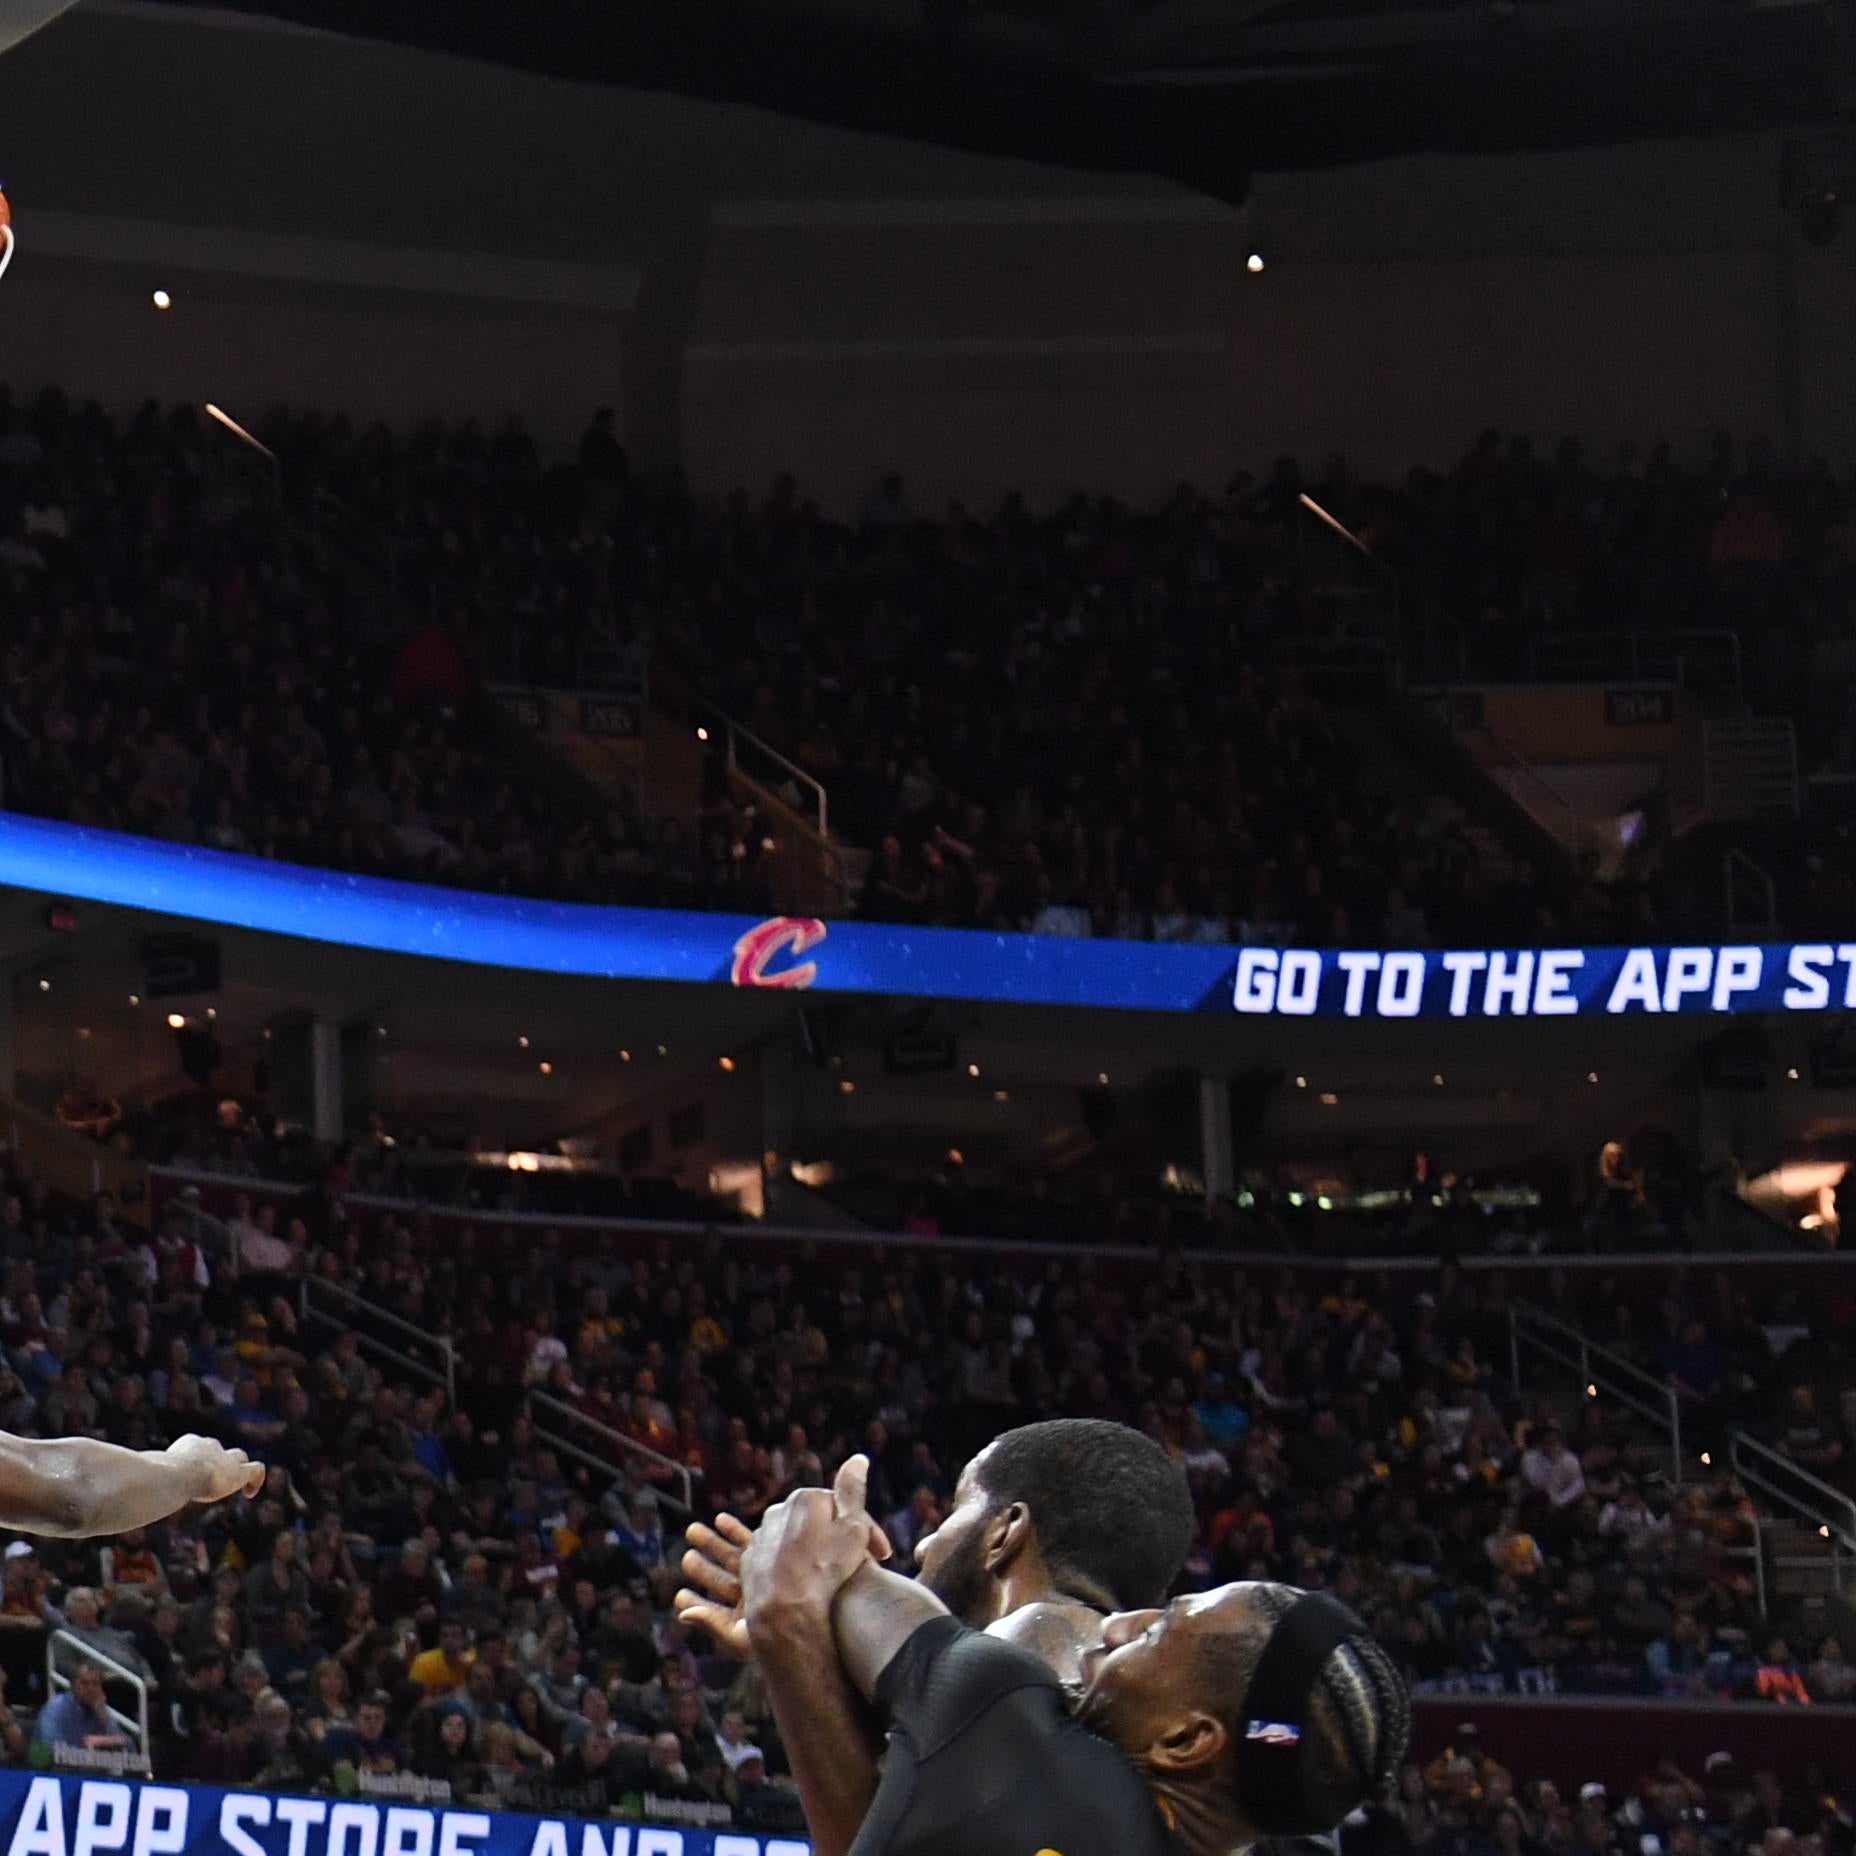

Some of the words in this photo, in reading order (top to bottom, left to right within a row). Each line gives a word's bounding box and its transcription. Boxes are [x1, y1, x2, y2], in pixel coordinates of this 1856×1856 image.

[1234, 947, 1322, 1015] GO
[1337, 951, 1427, 1017] TO
[1442, 949, 1586, 1017] THE
[1606, 945, 1764, 1014] APP
